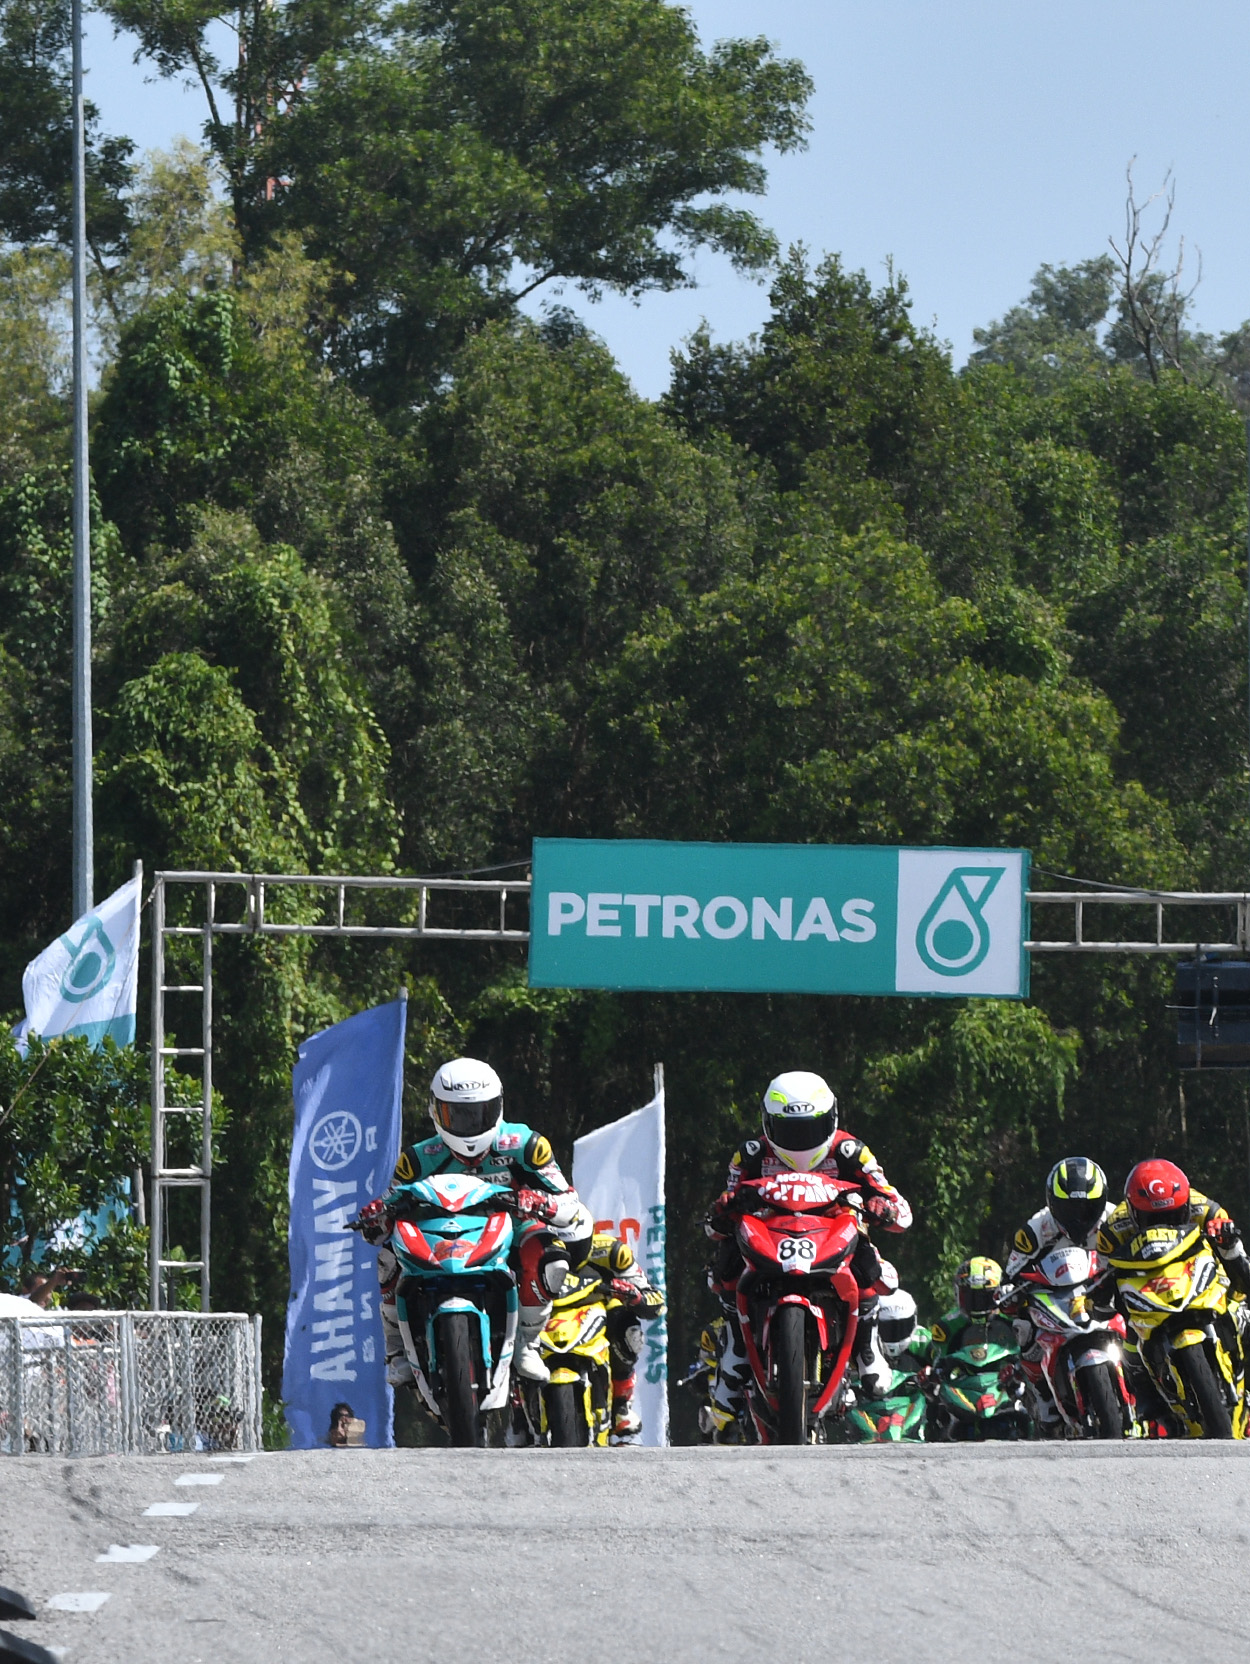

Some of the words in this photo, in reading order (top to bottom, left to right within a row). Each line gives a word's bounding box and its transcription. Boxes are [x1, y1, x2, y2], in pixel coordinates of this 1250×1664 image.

[547, 891, 877, 943] PETRONAS
[779, 1239, 815, 1260] 88
[645, 1205, 668, 1384] PETRNAS
